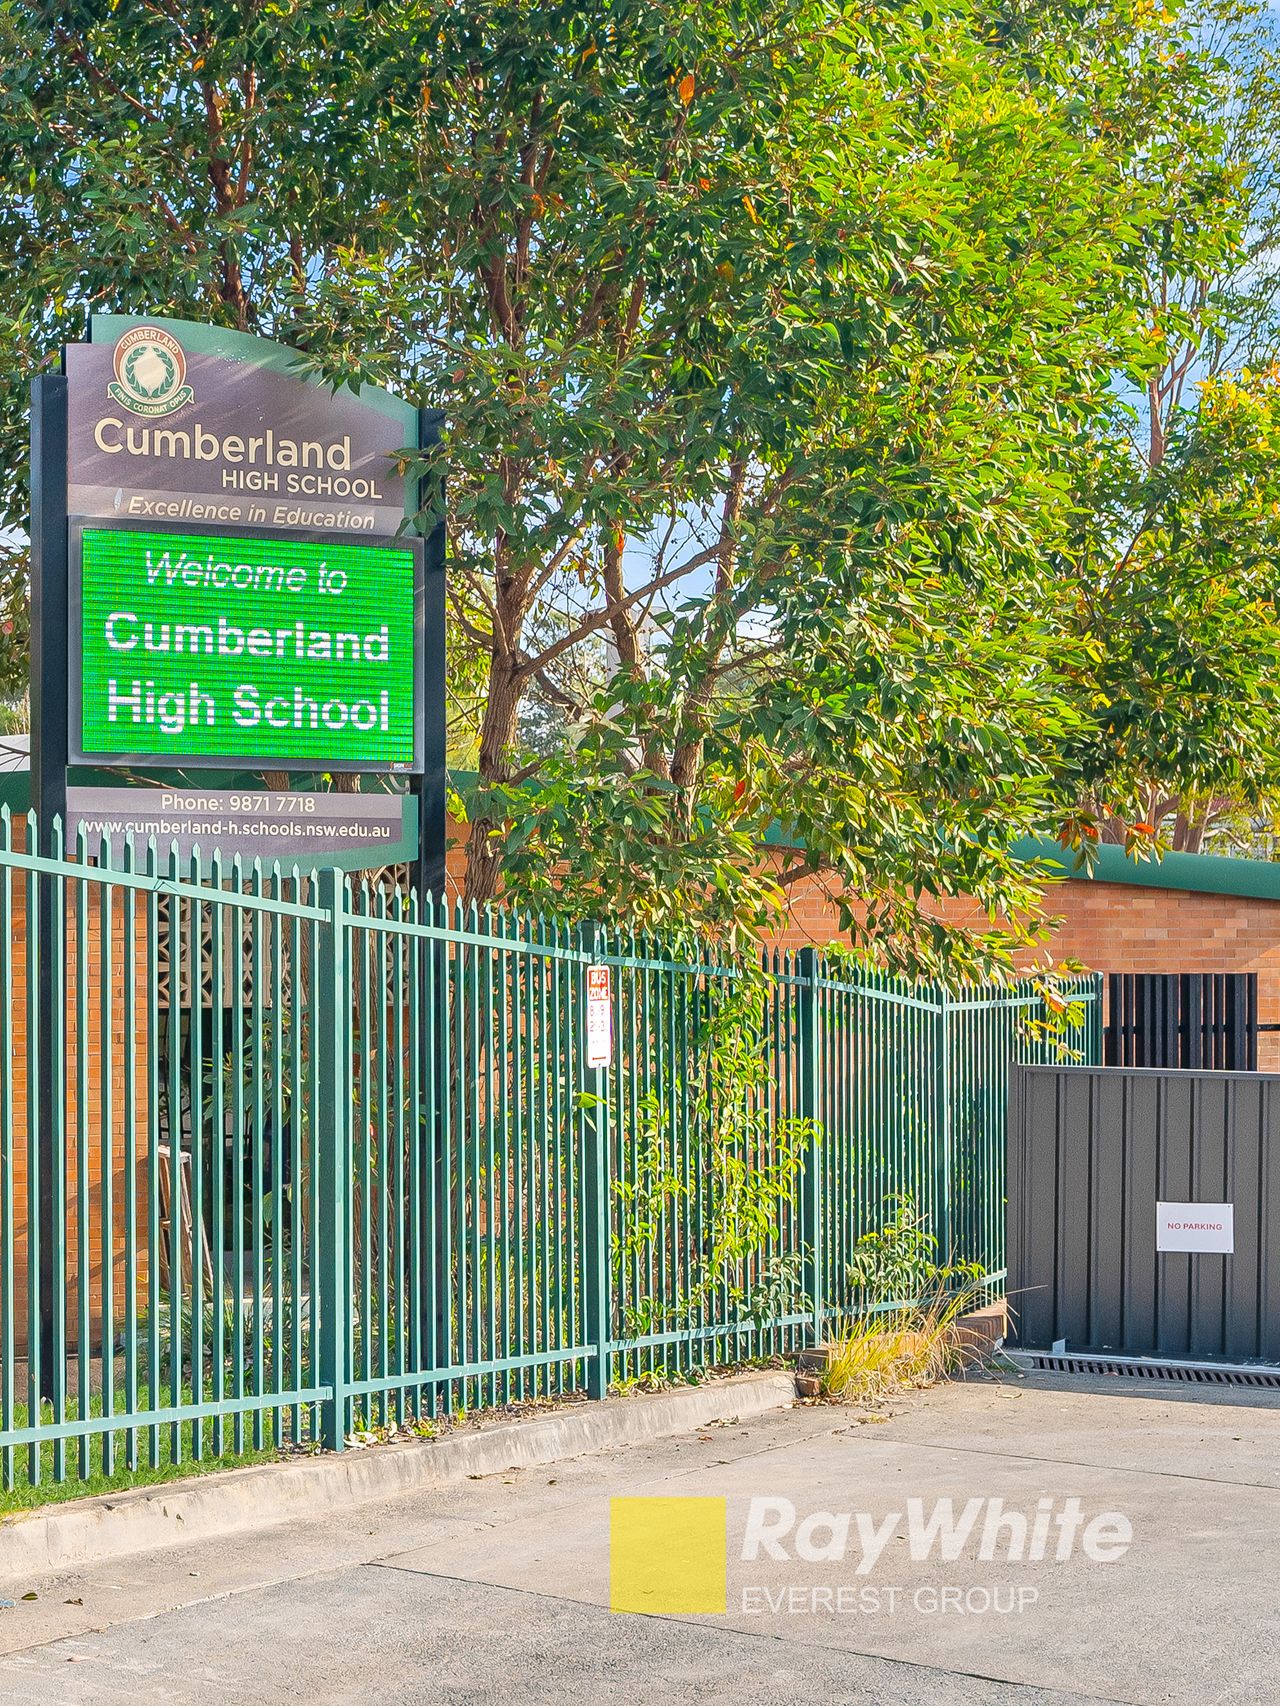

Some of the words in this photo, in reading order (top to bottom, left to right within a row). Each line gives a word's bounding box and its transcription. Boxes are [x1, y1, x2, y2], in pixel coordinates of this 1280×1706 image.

[121, 330, 179, 354] CUMBERLAND
[114, 388, 132, 406] FINIS
[133, 402, 168, 414] CORONAT
[169, 389, 187, 408] OPUS
[94, 417, 352, 471] Cumberland
[222, 469, 278, 493] HIGH
[287, 474, 383, 500] SCHOOL
[128, 496, 242, 522] Excellence
[248, 503, 266, 523] in
[273, 507, 375, 530] Education
[145, 550, 307, 593] Welcome
[317, 562, 348, 595] to
[105, 612, 389, 661] Cumberland
[107, 679, 216, 735] High
[232, 684, 389, 731] School
[161, 794, 223, 811] Phone:
[229, 795, 270, 812] 9871
[276, 797, 315, 813] 7718
[591, 971, 606, 985] BUS
[1167, 1222, 1181, 1230] NO
[1183, 1223, 1223, 1231] PARKING
